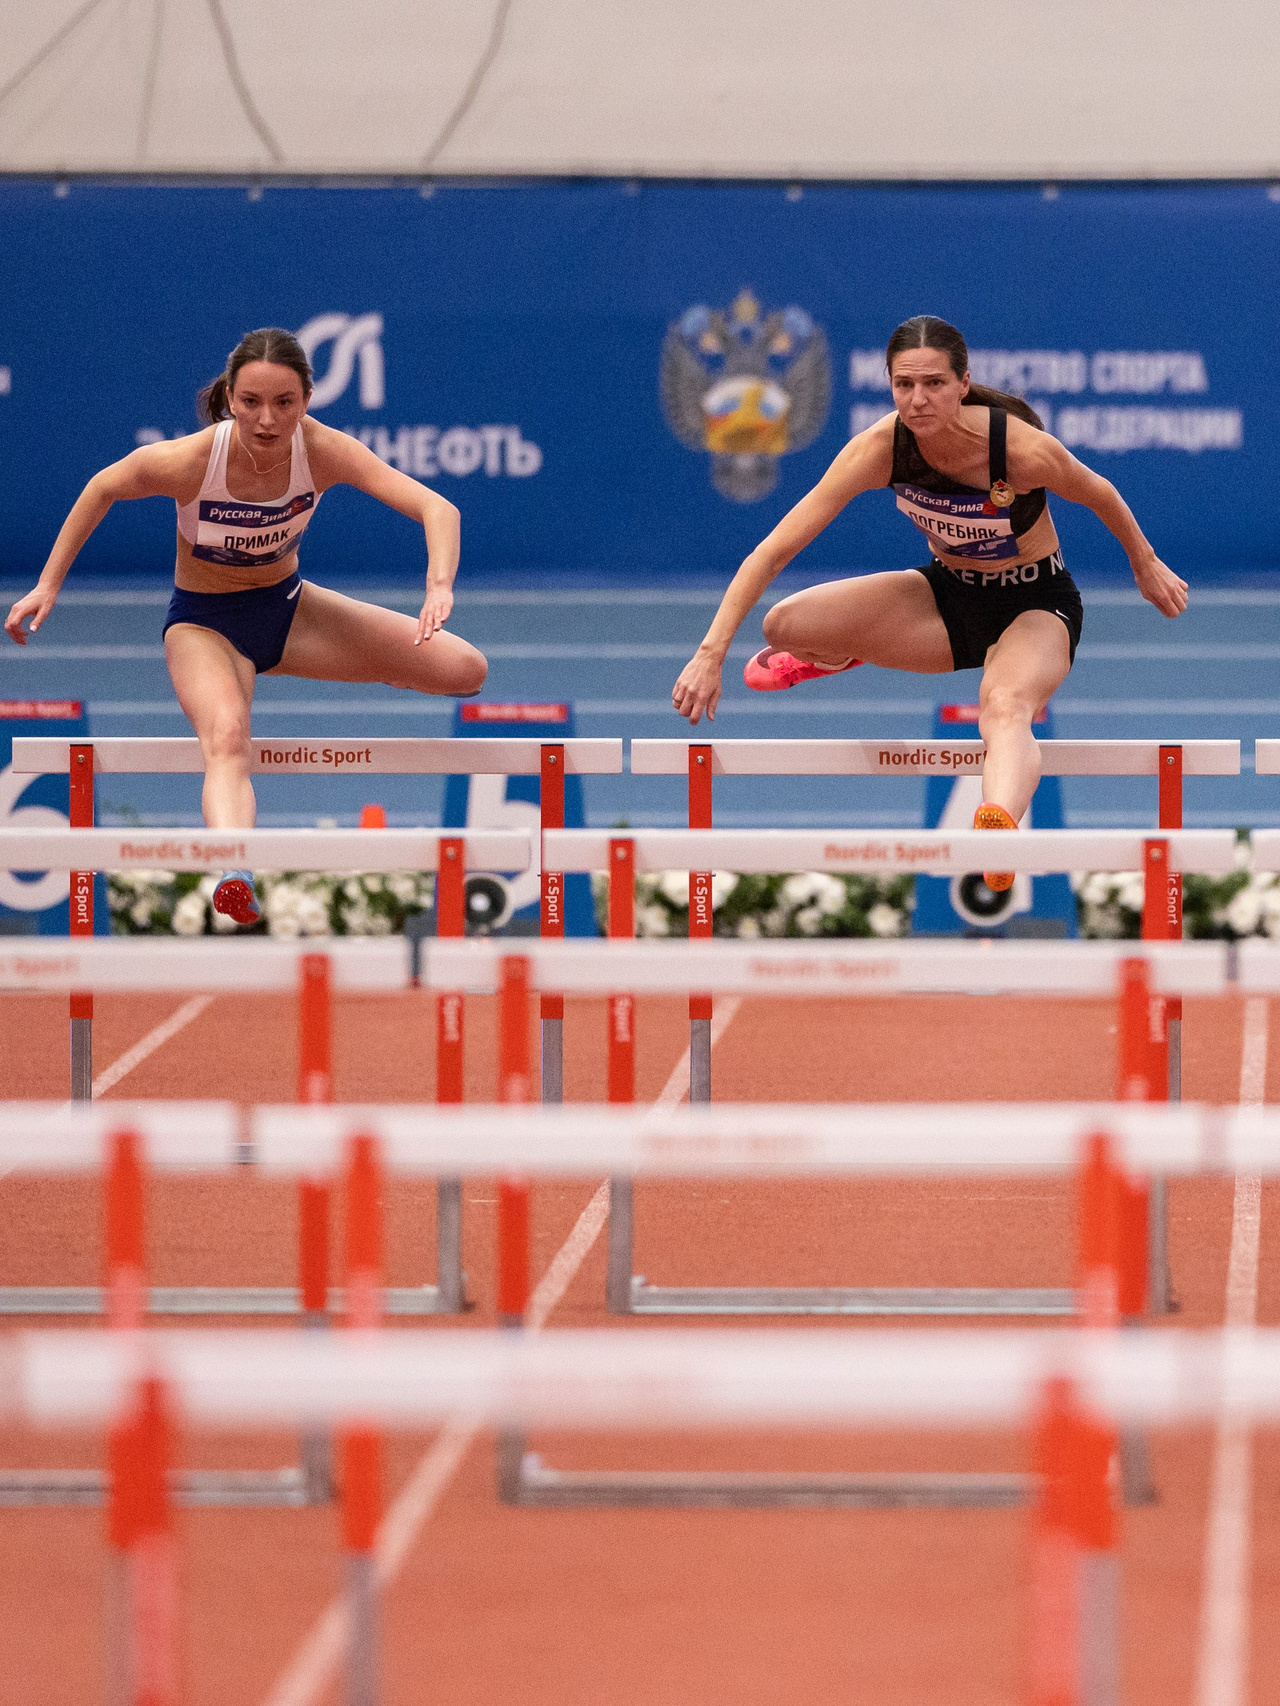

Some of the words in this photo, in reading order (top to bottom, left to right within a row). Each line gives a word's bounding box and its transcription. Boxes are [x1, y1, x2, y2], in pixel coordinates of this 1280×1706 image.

[904, 488, 951, 507] Русская
[209, 507, 262, 520] Русская
[908, 511, 999, 540] ПОГРЕБНЯК
[223, 527, 291, 549] ПРИМАК
[981, 562, 1039, 587] PRO
[322, 748, 372, 767] Sport
[74, 885, 89, 924] Sport
[545, 886, 560, 925] Sport
[693, 886, 709, 925] Sport
